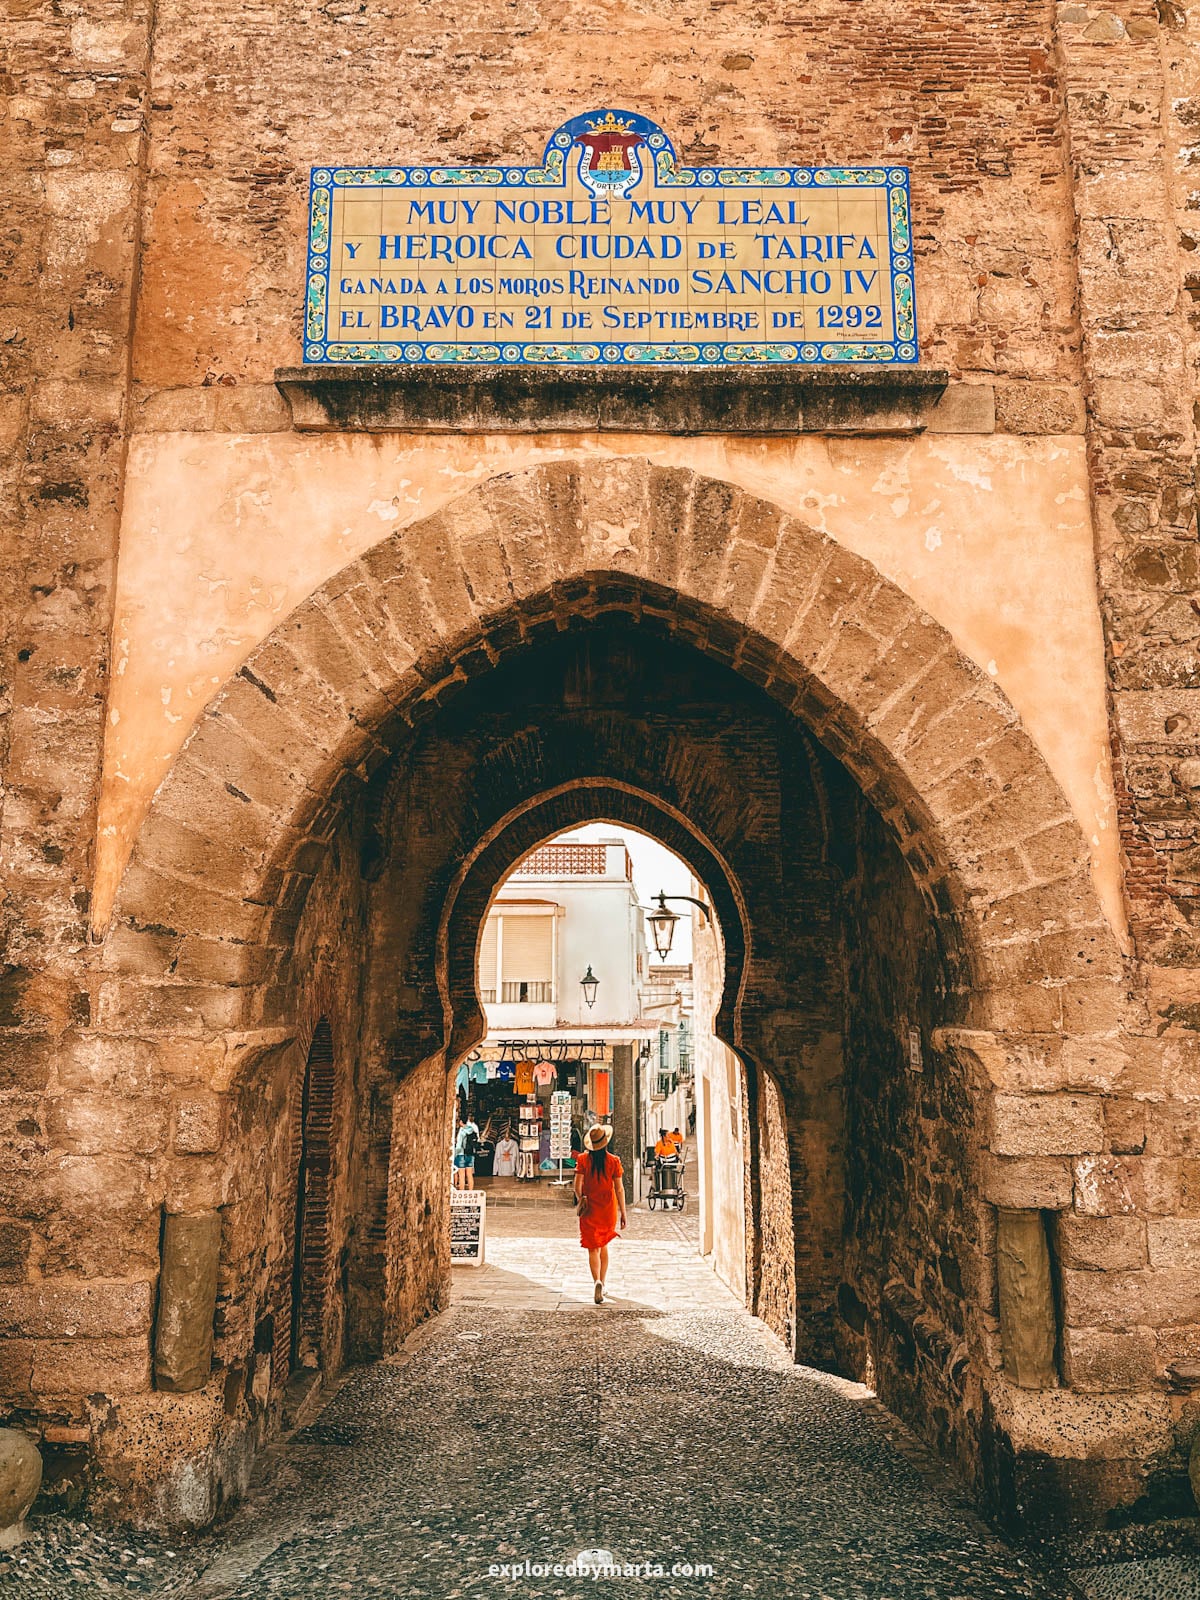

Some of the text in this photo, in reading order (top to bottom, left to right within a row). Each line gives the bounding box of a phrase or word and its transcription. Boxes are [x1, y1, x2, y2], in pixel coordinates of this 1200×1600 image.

[590, 180, 625, 190] FORTES
[626, 176, 636, 186] IN
[406, 199, 810, 226] MUY NOBLE MUY LEAL
[343, 233, 877, 264] Y HEROICA CIUDAD DE TARIFA
[339, 278, 427, 295] GANADA
[435, 278, 448, 295] A
[455, 278, 494, 294] LOS
[498, 278, 564, 298] MOROS
[690, 270, 833, 294] SANCHO
[843, 270, 878, 294] IV
[340, 311, 372, 329] EL
[380, 305, 474, 332] BRAVO
[483, 312, 514, 329] EN
[524, 305, 553, 329] 21
[562, 312, 593, 329] DE
[772, 312, 804, 329] DE
[815, 305, 883, 329] 1292
